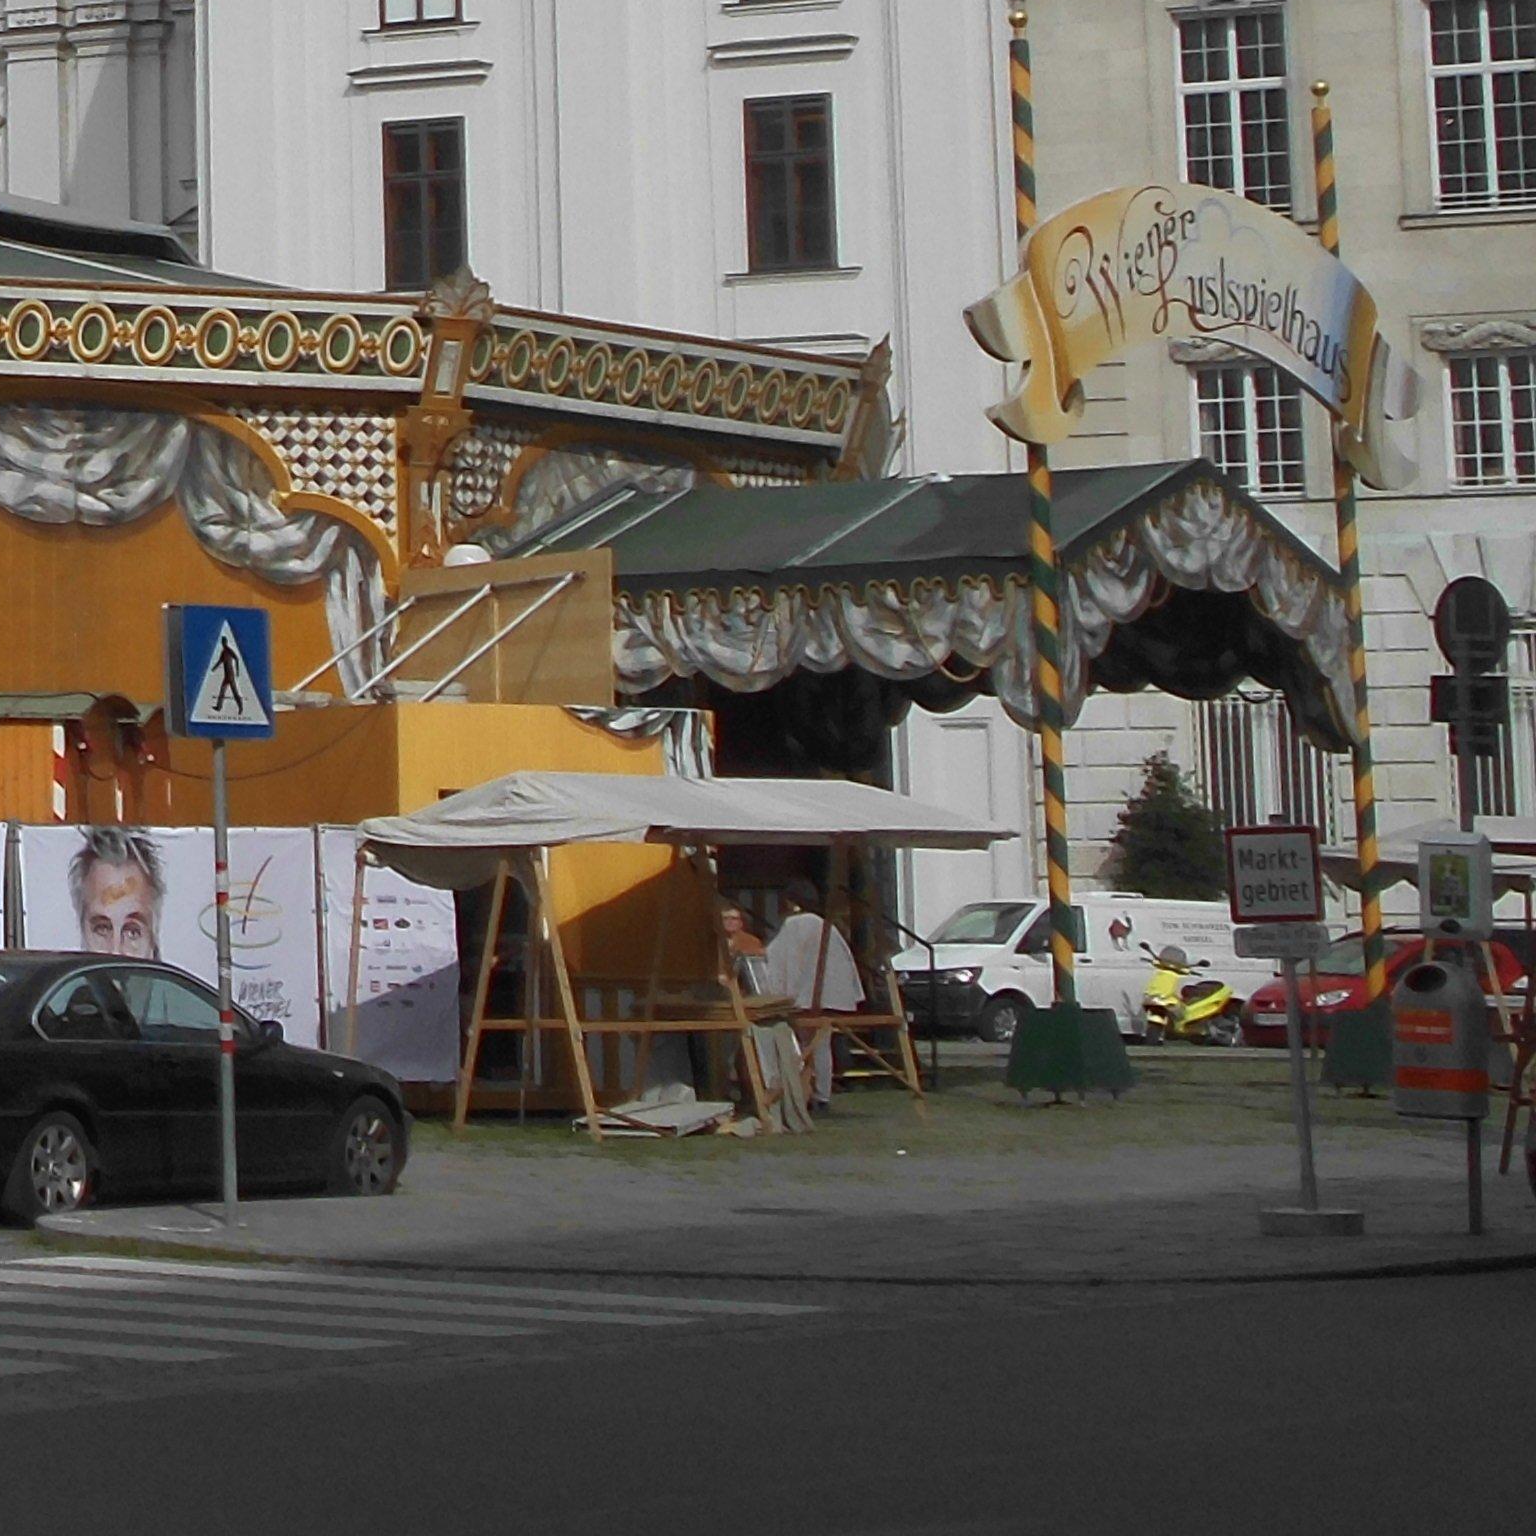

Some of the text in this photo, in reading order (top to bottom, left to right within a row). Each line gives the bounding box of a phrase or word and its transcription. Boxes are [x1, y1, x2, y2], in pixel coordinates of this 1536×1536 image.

[1052, 186, 1195, 348] Wiener
[1238, 848, 1308, 871] Markt-
[1242, 878, 1311, 907] gebiet
